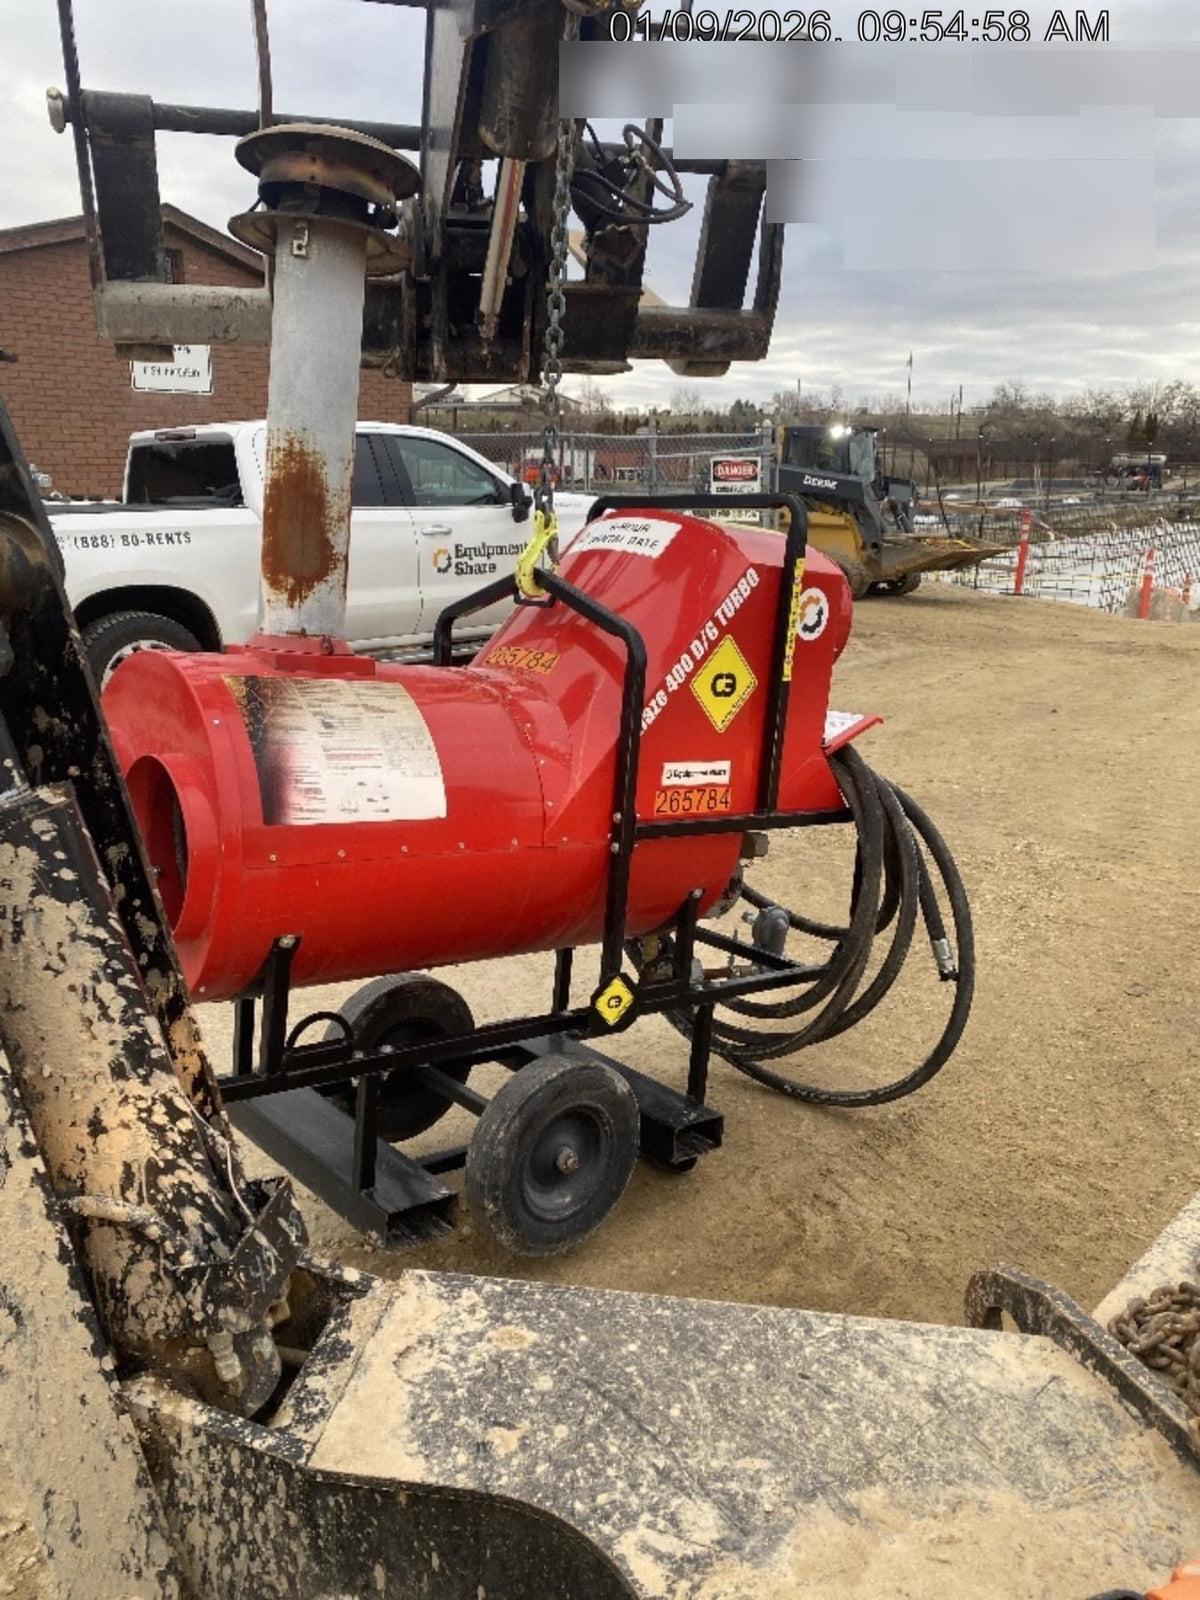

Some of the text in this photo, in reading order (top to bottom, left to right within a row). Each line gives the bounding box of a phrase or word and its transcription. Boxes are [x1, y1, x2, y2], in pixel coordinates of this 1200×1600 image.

[717, 464, 753, 476] DANGER
[120, 531, 191, 546] 80-RENTS
[454, 561, 496, 576] Share
[664, 654, 694, 692] 400
[714, 567, 759, 626] TURBO
[656, 787, 730, 813] 265784
